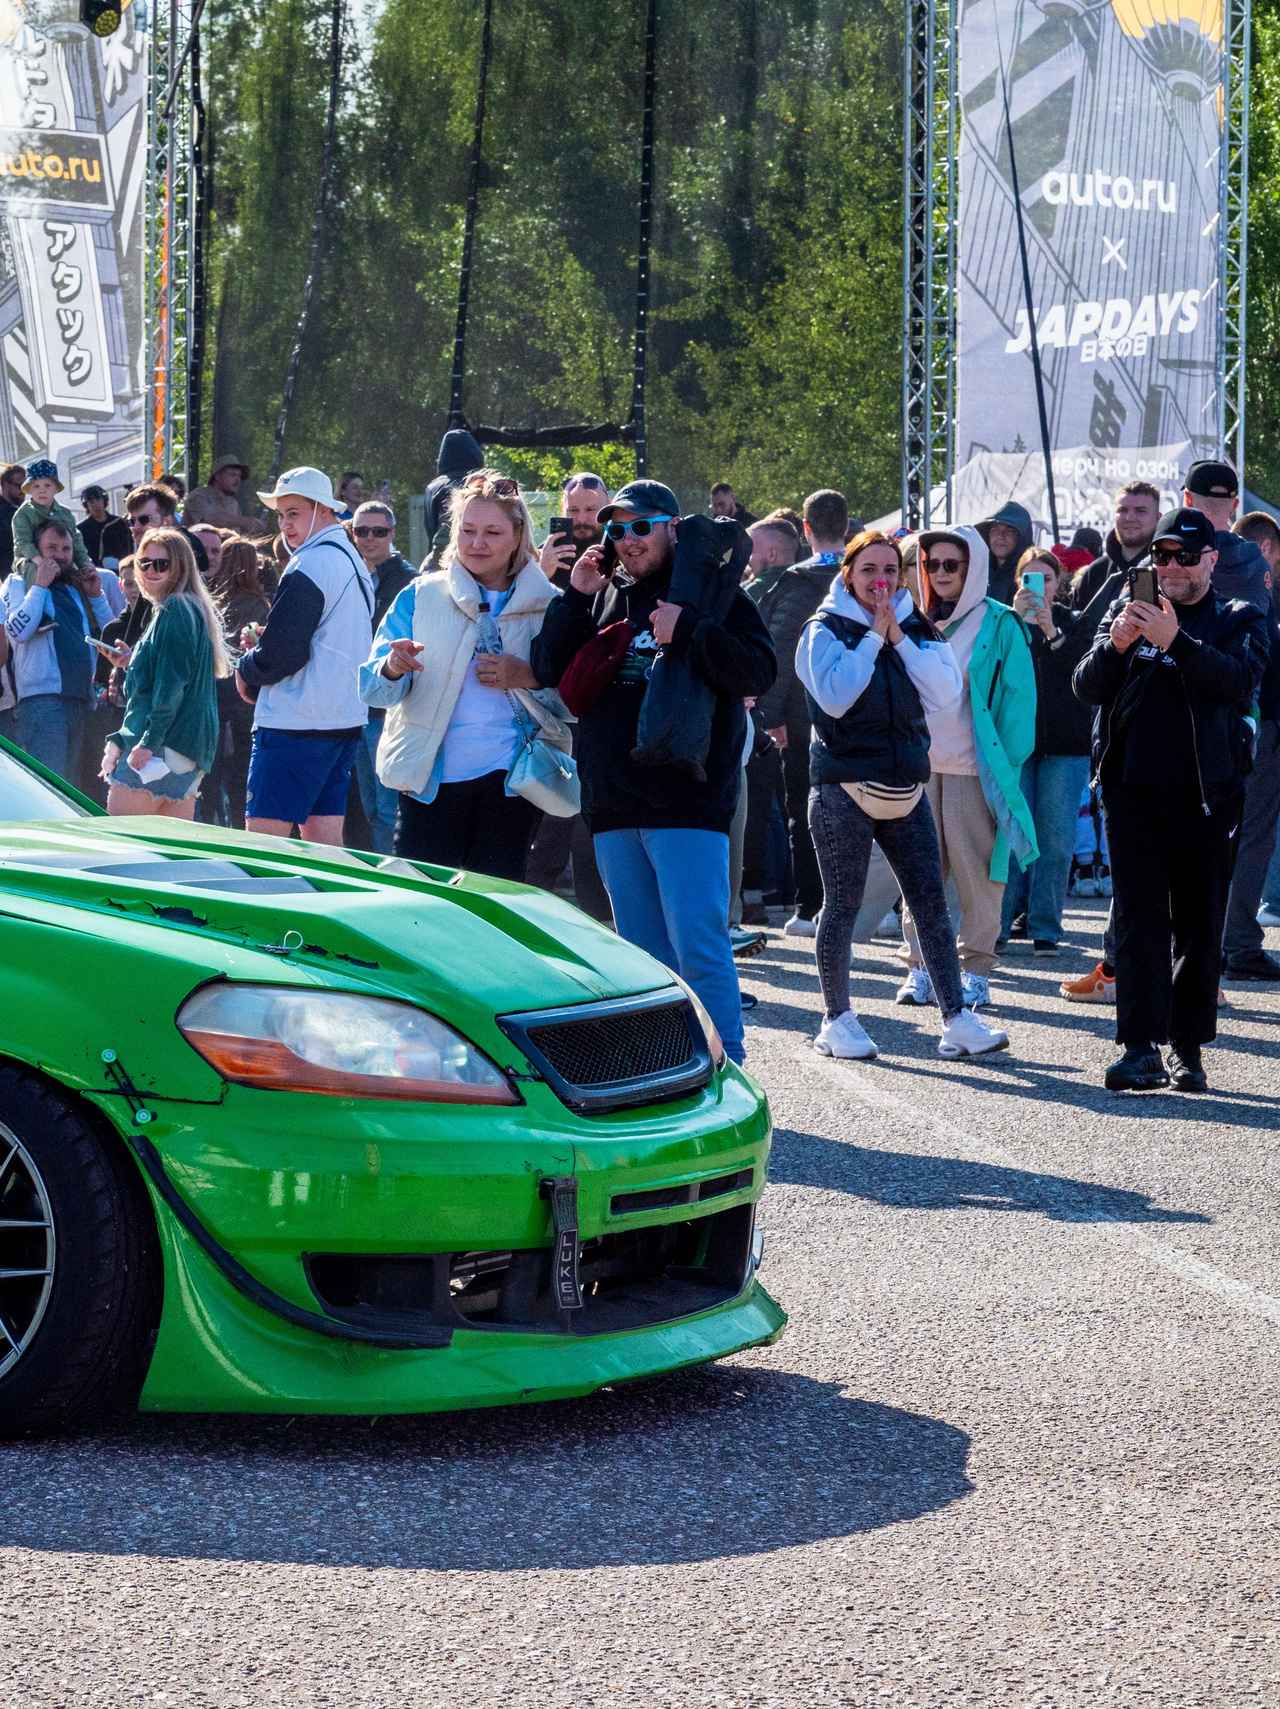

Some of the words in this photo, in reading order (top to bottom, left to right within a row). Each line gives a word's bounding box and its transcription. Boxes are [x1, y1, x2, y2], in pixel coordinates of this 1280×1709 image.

[1041, 169, 1177, 213] auto.ru
[44, 221, 93, 387] アタック
[1005, 289, 1201, 354] JAPDAYS
[1080, 335, 1148, 363] 日本の日
[560, 1235, 574, 1293] LUKE
